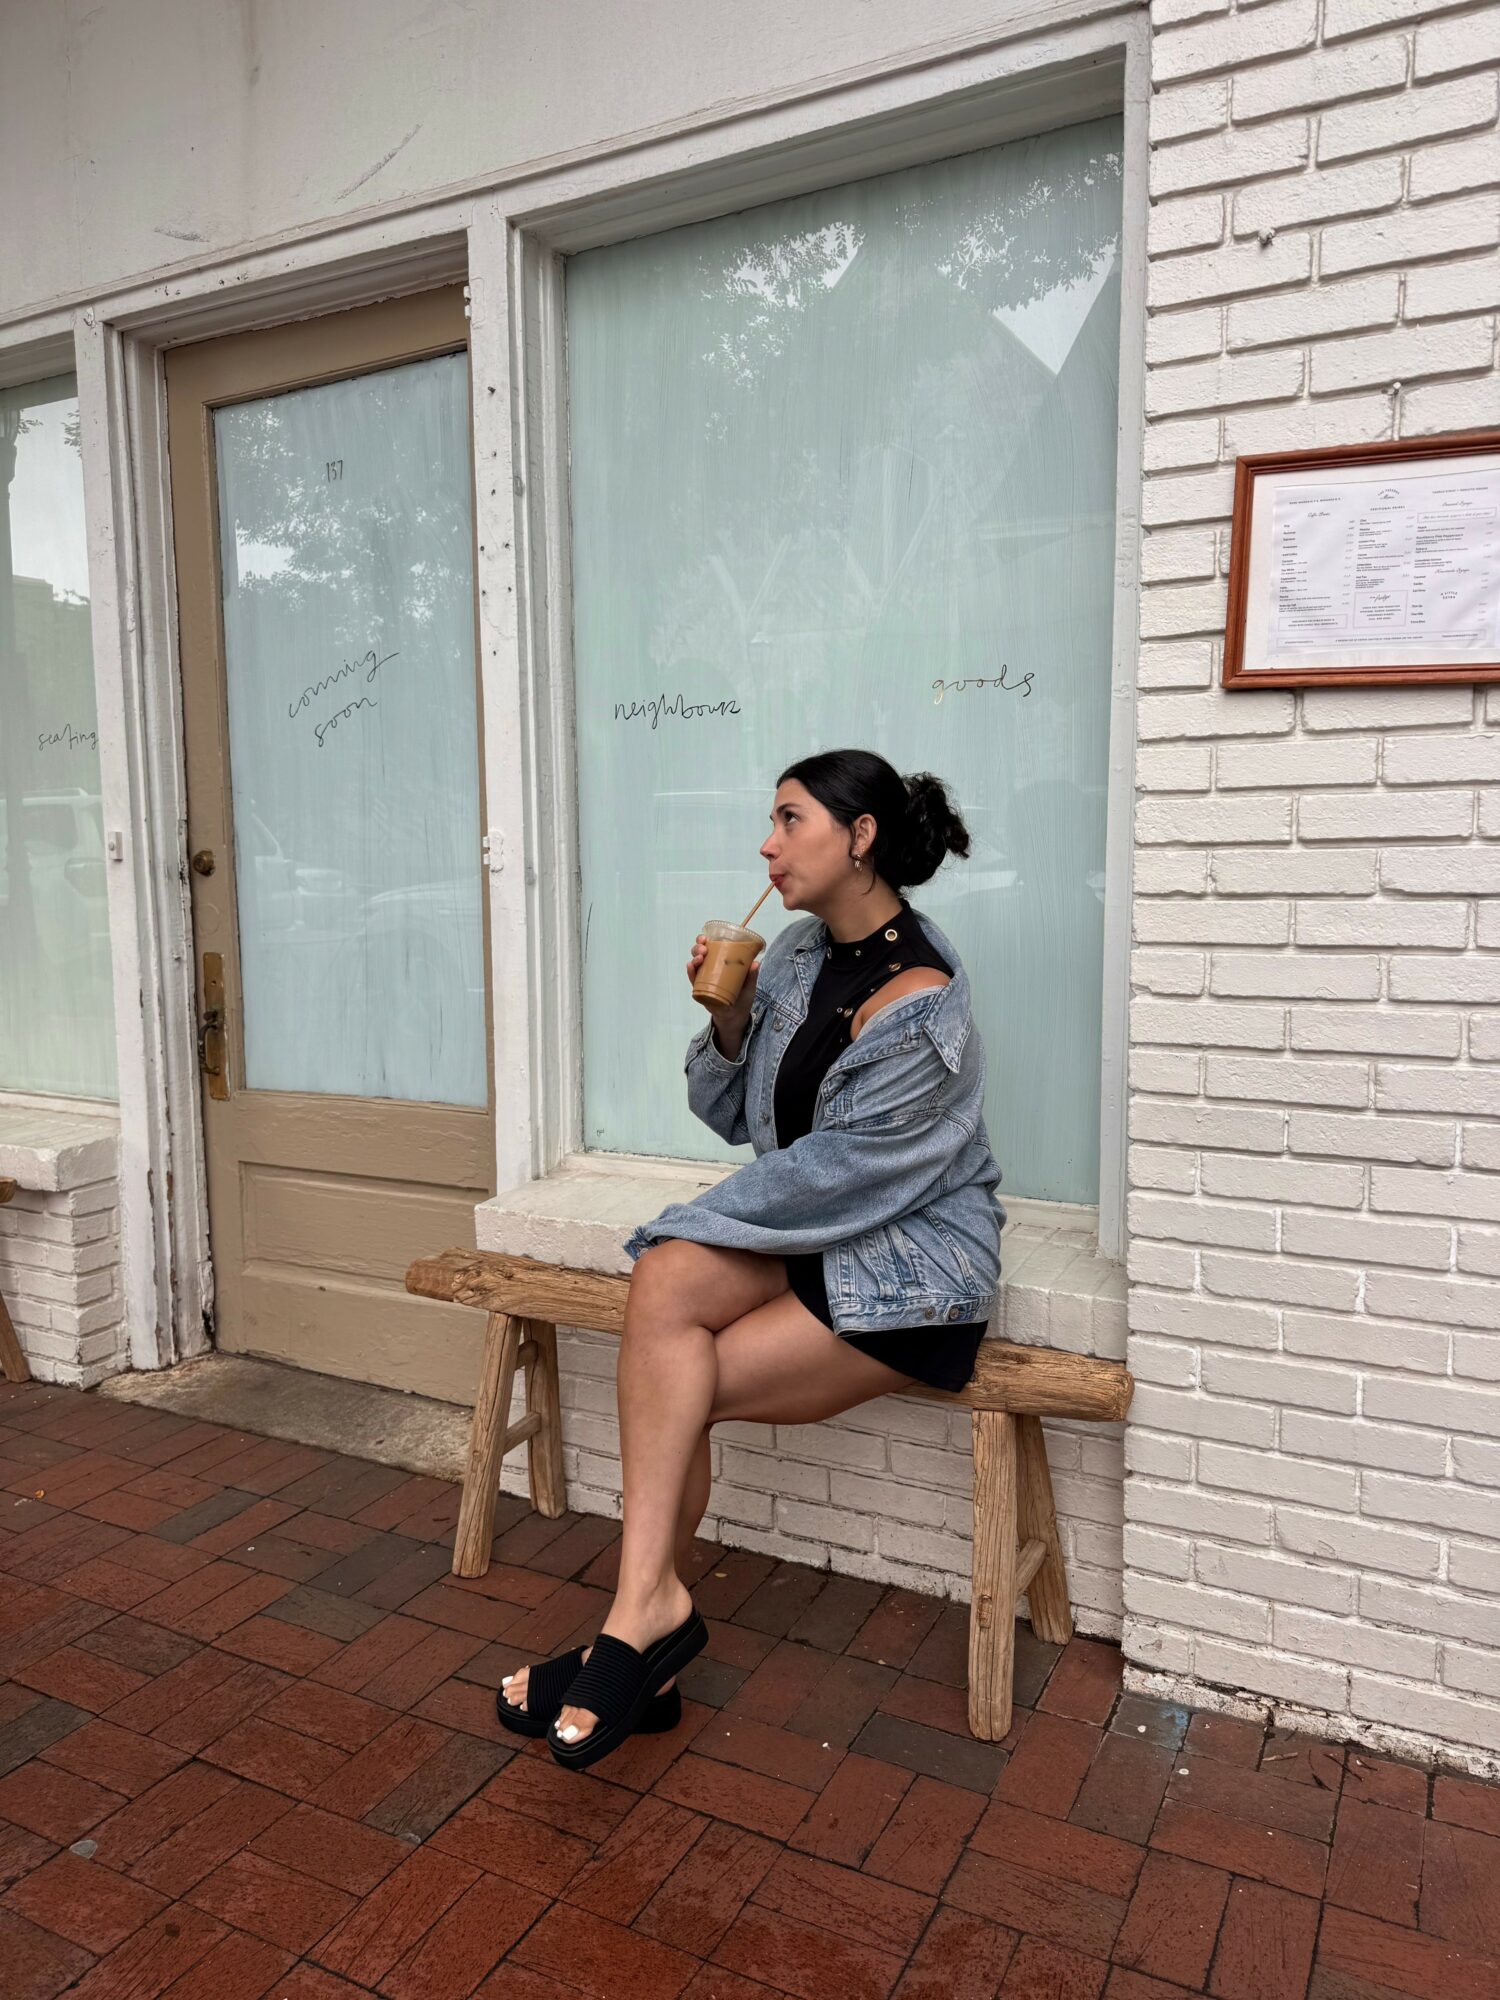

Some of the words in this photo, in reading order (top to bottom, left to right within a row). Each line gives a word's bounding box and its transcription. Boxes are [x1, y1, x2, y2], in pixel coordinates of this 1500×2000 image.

[326, 460, 343, 482] 137
[289, 650, 400, 718] coming
[932, 664, 1035, 705] goods
[38, 723, 99, 752] seating
[314, 697, 378, 748] soon
